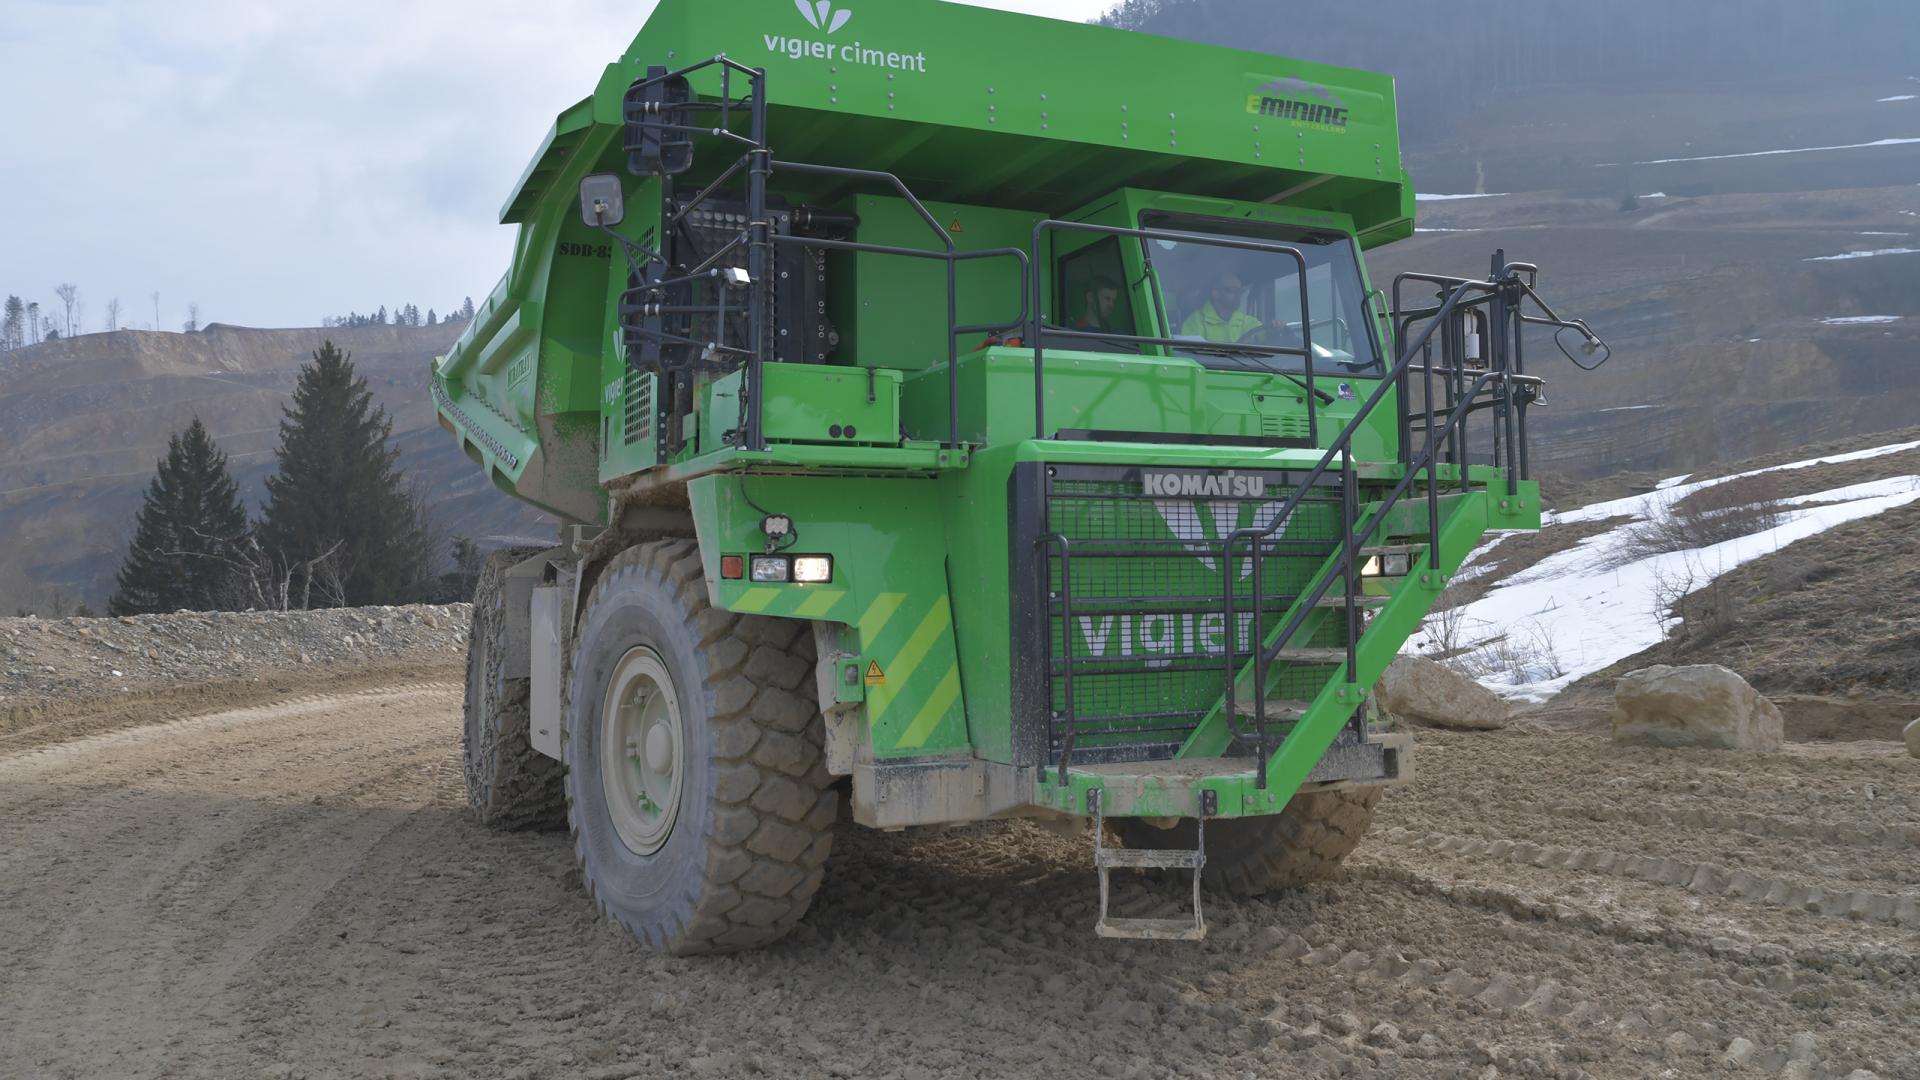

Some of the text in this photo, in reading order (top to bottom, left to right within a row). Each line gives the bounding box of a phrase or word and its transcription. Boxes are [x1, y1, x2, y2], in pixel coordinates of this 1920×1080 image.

[764, 34, 926, 73] vigier ciment
[1144, 473, 1264, 497] KOMATSU
